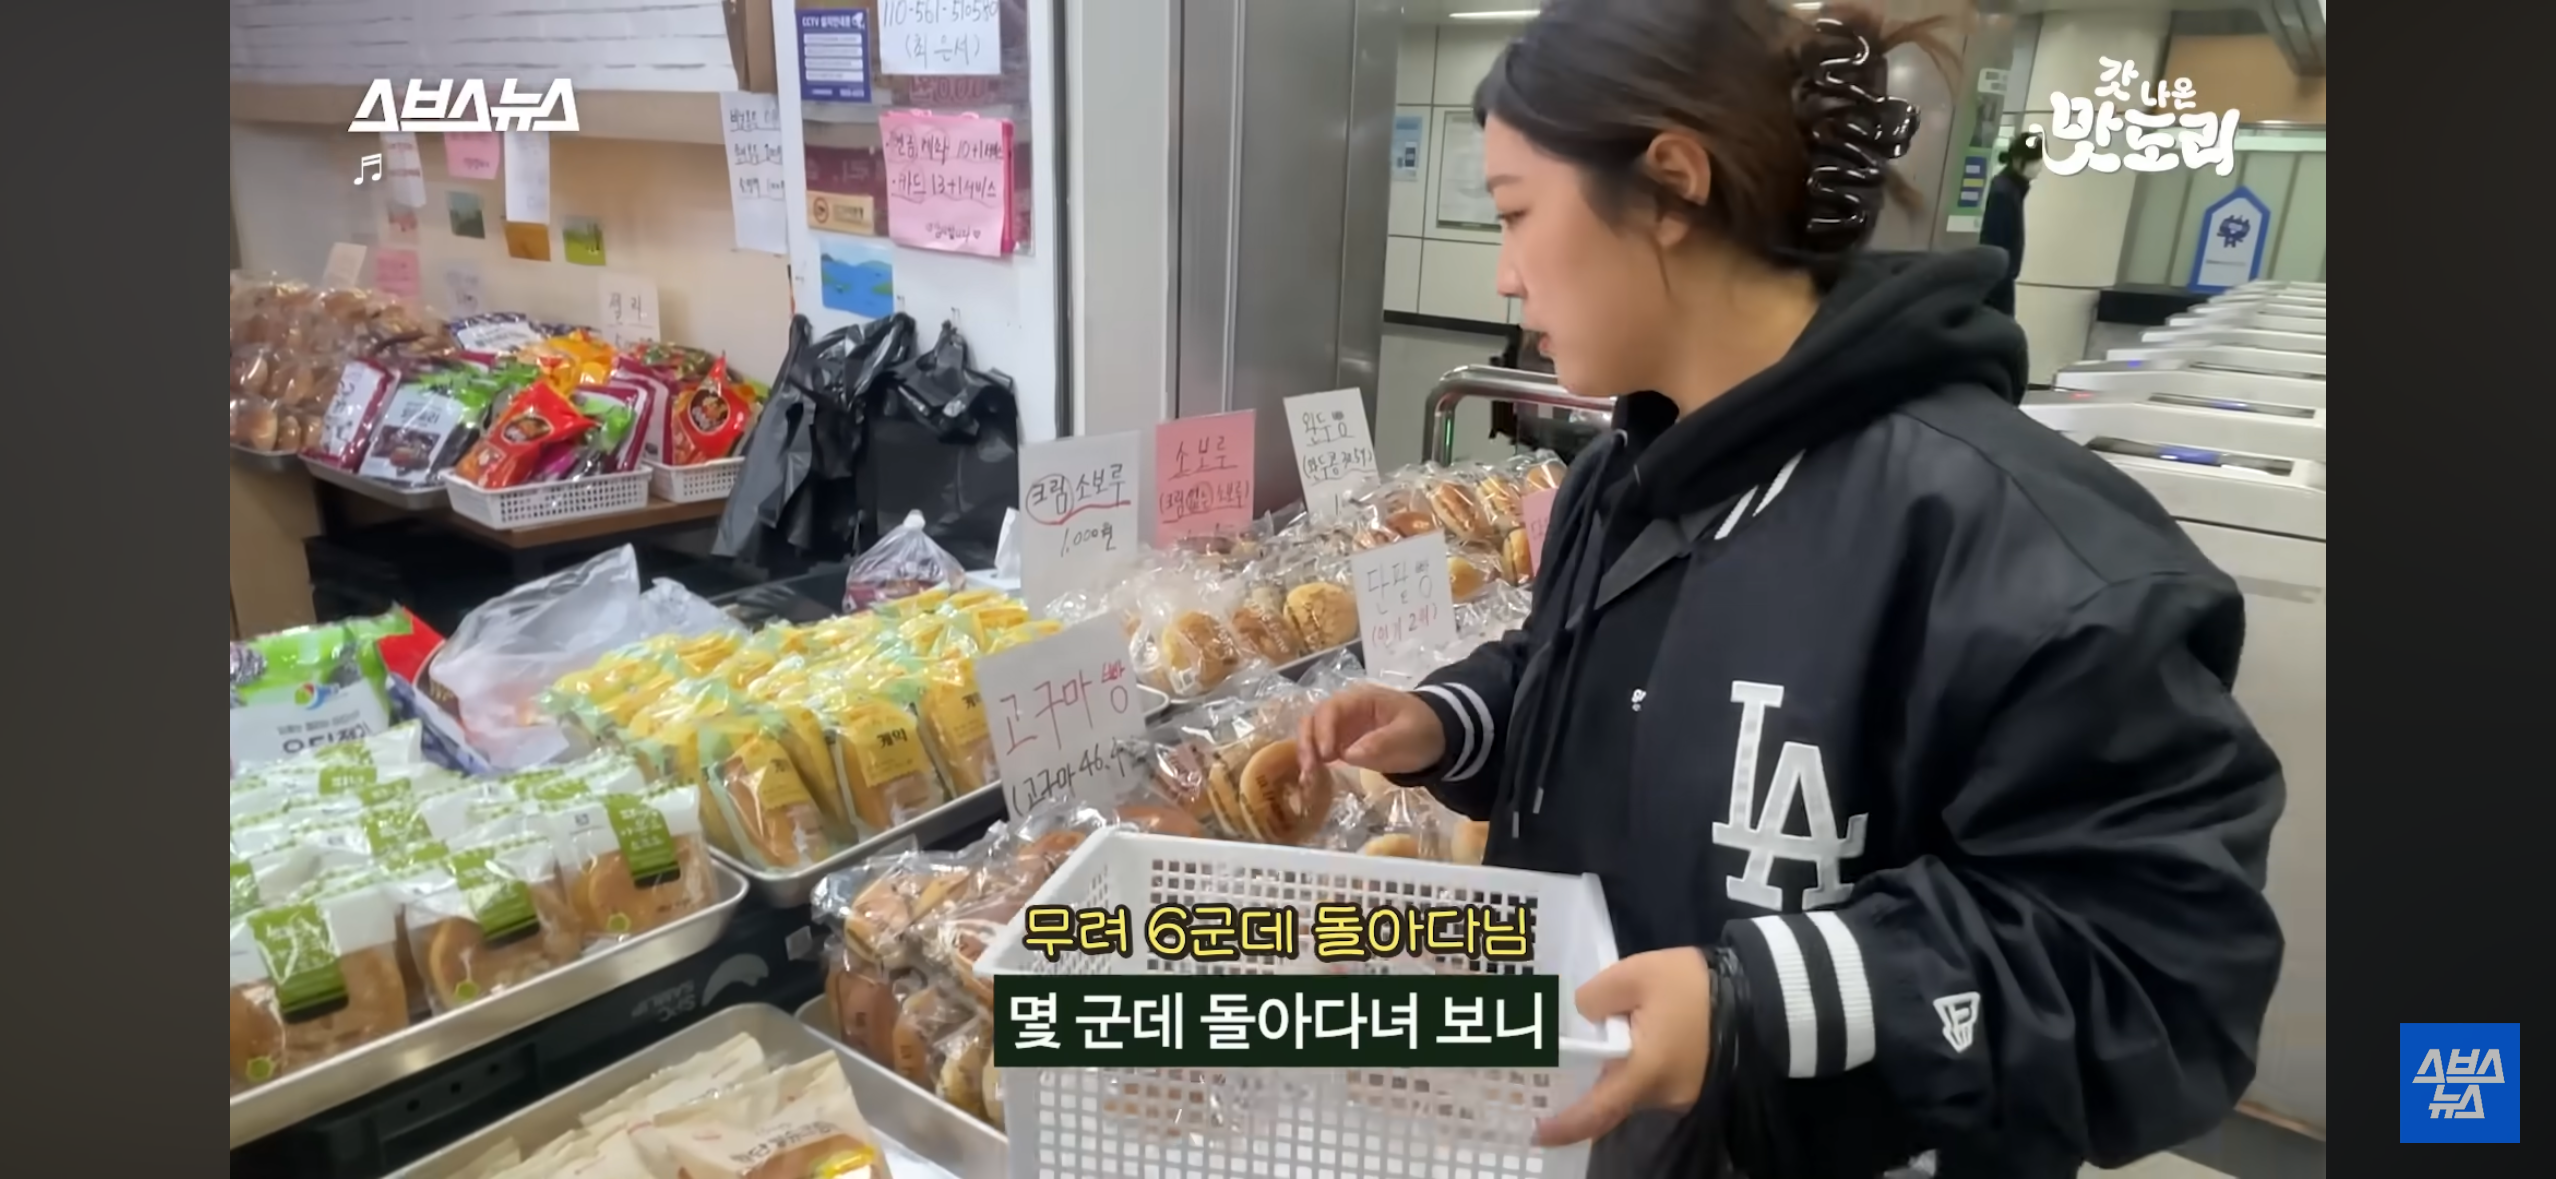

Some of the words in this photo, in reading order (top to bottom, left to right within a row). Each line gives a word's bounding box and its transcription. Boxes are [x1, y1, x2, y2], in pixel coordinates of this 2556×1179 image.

[1175, 435, 1227, 474] 소보루
[999, 670, 1093, 756] 고구마
[1101, 659, 1127, 714] 빵
[1712, 681, 1869, 911] LA
